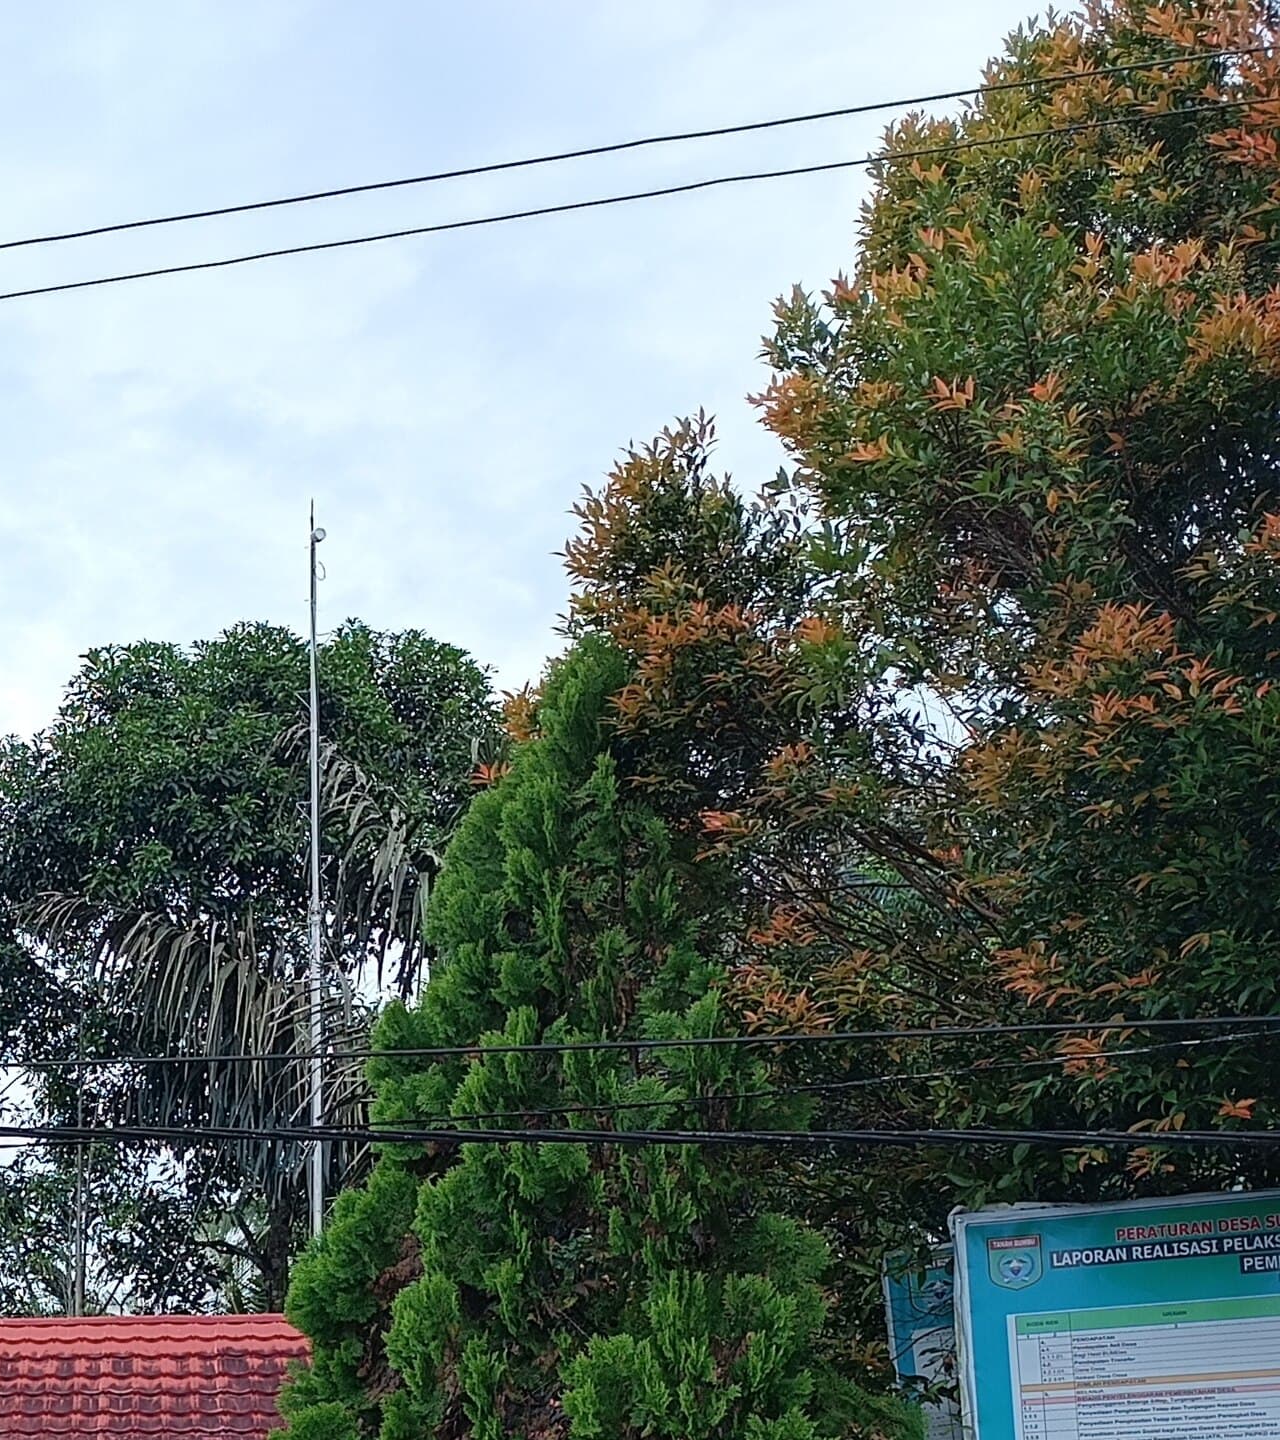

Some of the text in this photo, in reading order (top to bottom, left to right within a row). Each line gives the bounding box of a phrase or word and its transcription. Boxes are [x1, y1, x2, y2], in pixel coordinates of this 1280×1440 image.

[1116, 1223, 1212, 1242] PERATURAN
[1219, 1218, 1259, 1233] DESA
[1053, 1246, 1127, 1267] LAPORAN
[1132, 1239, 1219, 1260] REALISASI
[1244, 1257, 1280, 1271] PEM
